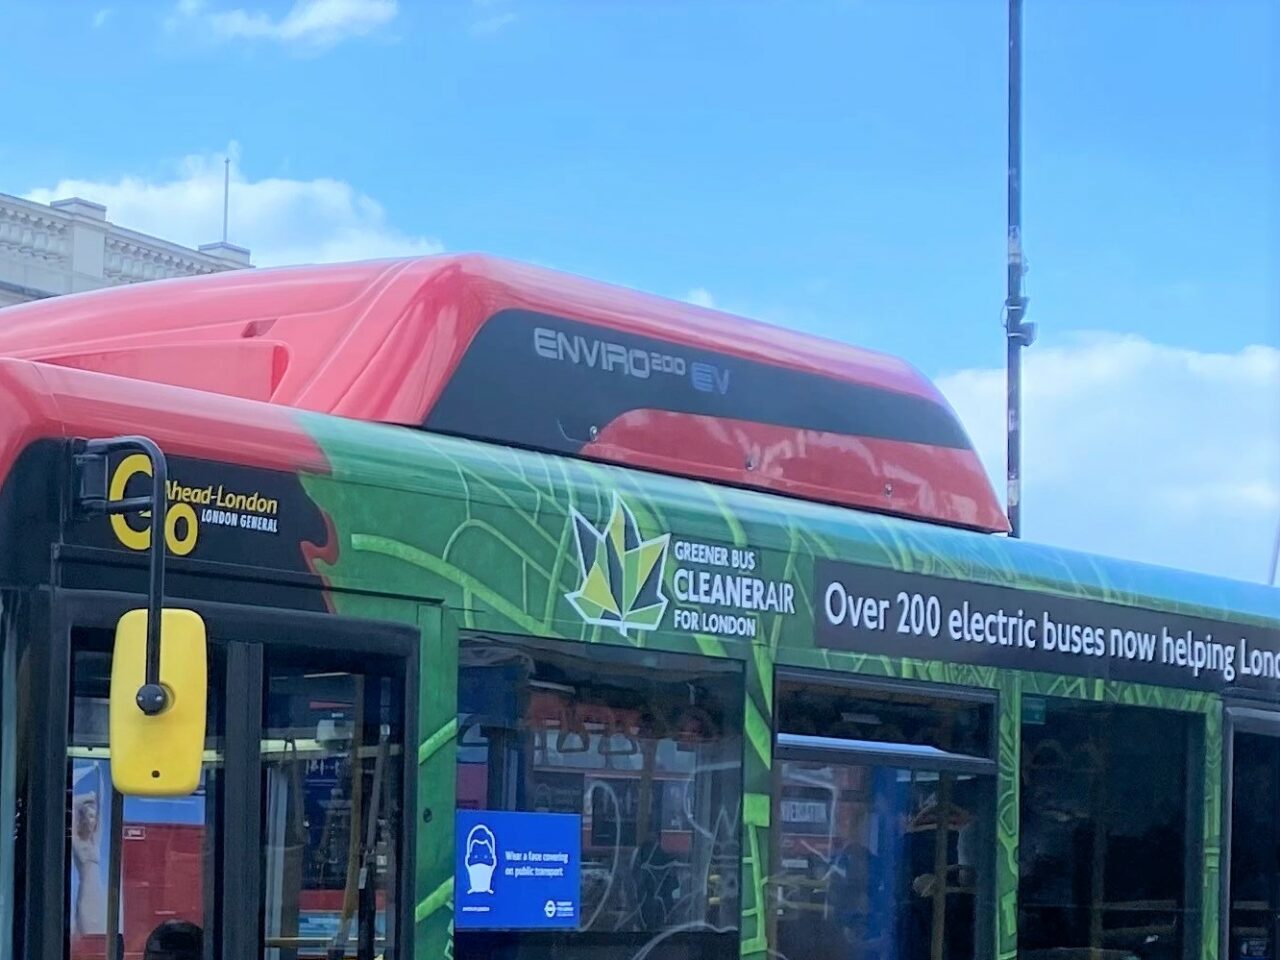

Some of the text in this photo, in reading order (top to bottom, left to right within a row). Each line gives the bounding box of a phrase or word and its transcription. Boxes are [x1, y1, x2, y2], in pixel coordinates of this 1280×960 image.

[691, 361, 730, 394] EV
[201, 509, 278, 533] LONDON GENERAL
[674, 541, 756, 571] GREENER BUS
[674, 609, 756, 637] FOR LONDON
[825, 582, 890, 630] Over
[896, 591, 941, 638] 200
[948, 601, 1036, 649] electric
[1043, 610, 1105, 657] buses
[1109, 626, 1156, 662] now
[1161, 626, 1236, 681] helping
